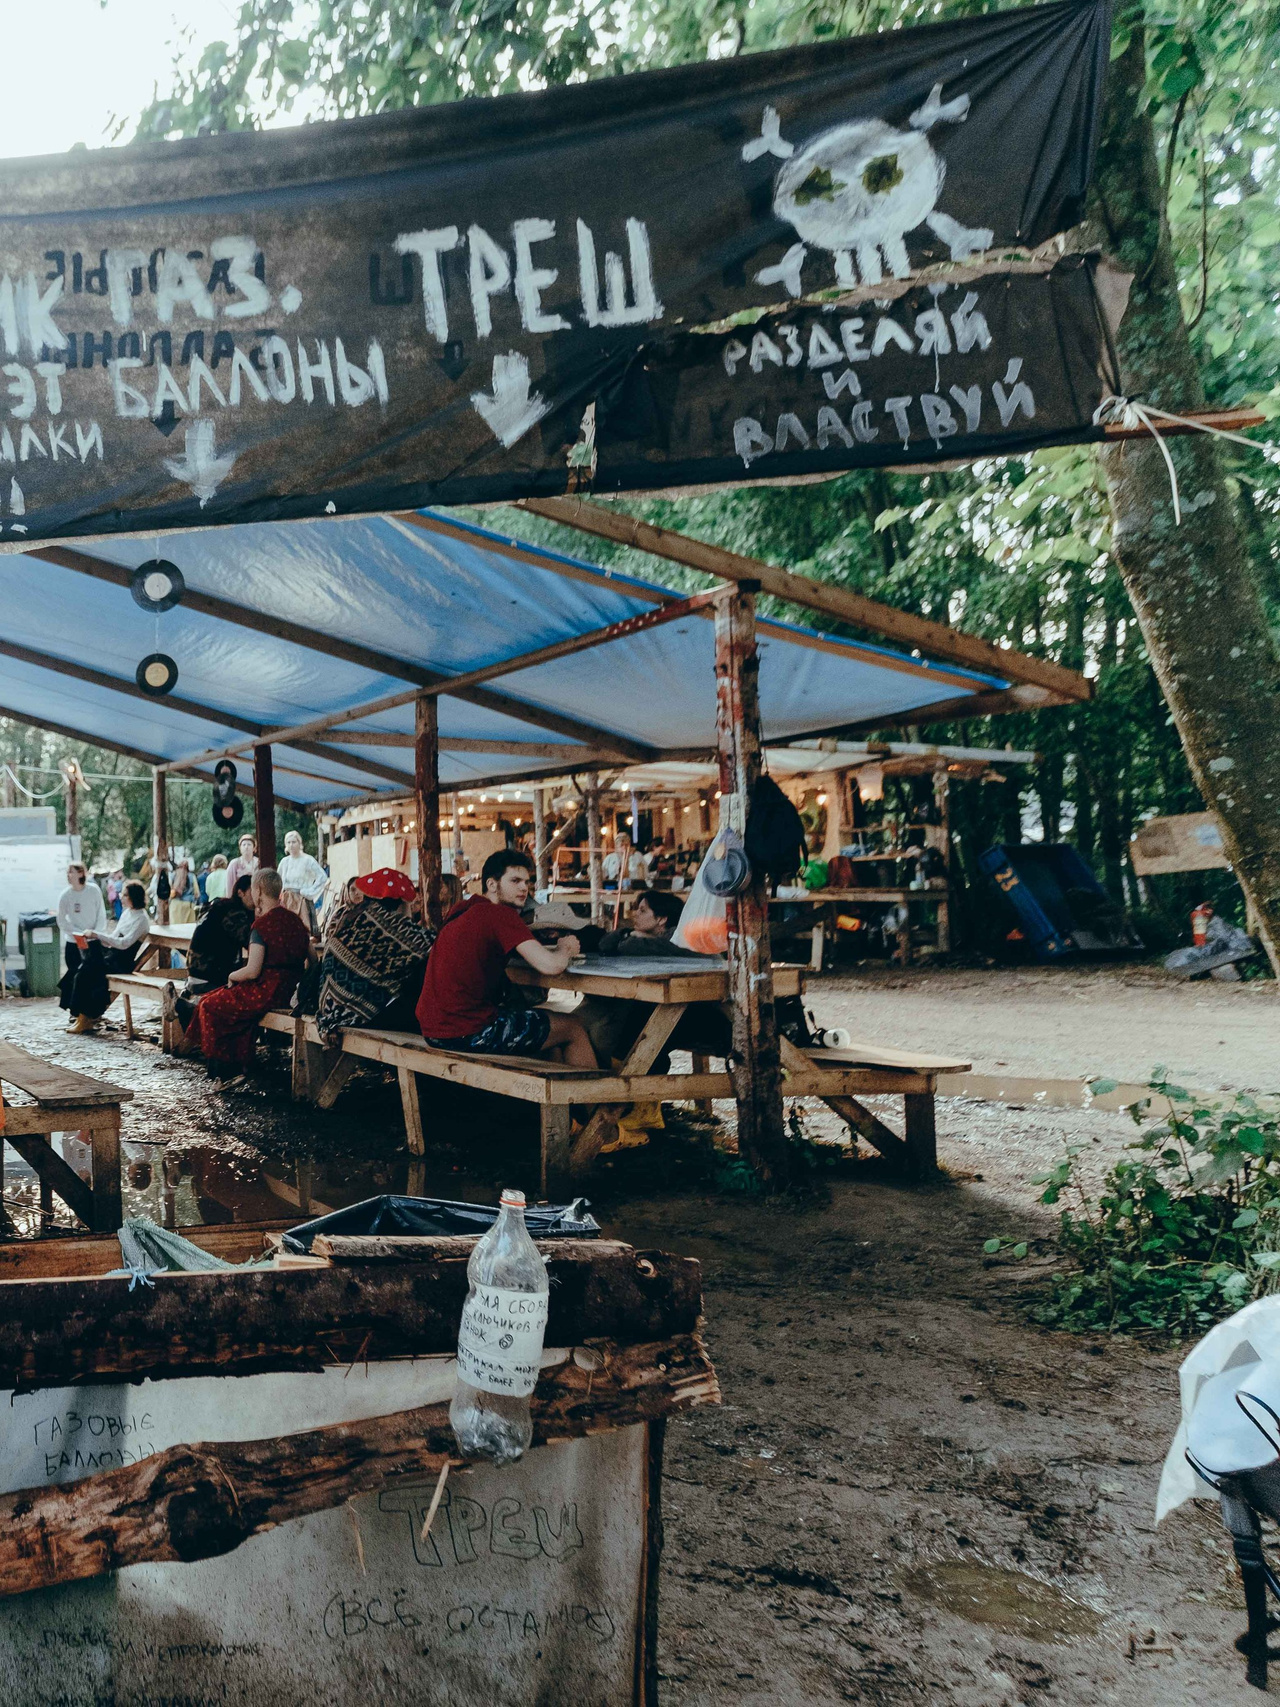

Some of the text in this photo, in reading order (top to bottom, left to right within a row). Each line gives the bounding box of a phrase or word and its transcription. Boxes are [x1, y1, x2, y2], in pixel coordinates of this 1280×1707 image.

[392, 216, 665, 344] ТРЕШ
[723, 291, 993, 376] РАЗДЕЛЯЙ
[106, 335, 390, 418] БАЛЛОНЫ
[733, 356, 1037, 462] ВЛАСТВУЙ
[822, 368, 862, 399] И
[34, 1411, 155, 1446] ГАЗОВЫЕ
